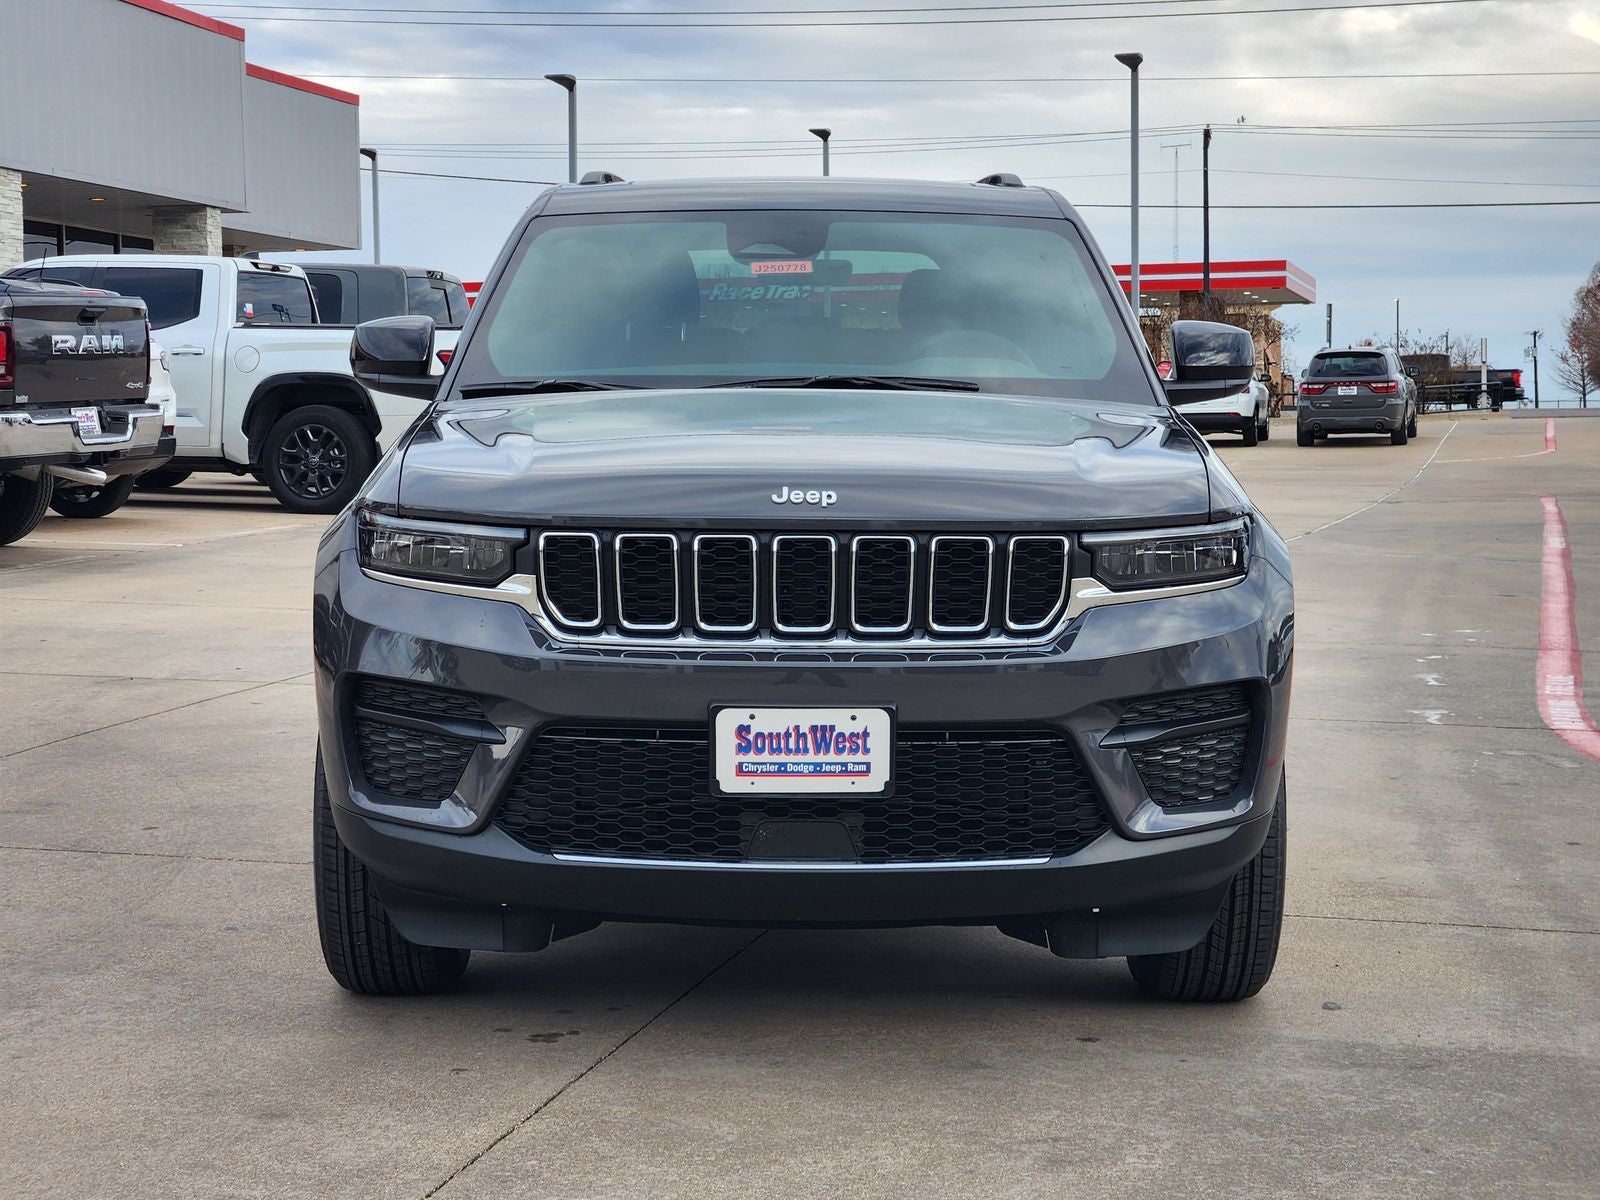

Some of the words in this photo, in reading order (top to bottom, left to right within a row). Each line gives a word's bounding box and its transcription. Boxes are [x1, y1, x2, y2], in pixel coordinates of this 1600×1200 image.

[755, 263, 808, 273] J250778
[51, 334, 125, 355] RAM
[771, 486, 838, 508] Jeep
[735, 724, 871, 756] SouthWest
[742, 763, 779, 774] Chrysler
[786, 763, 814, 774] Dodge
[821, 763, 842, 774] Jeep
[847, 763, 867, 772] Ram
